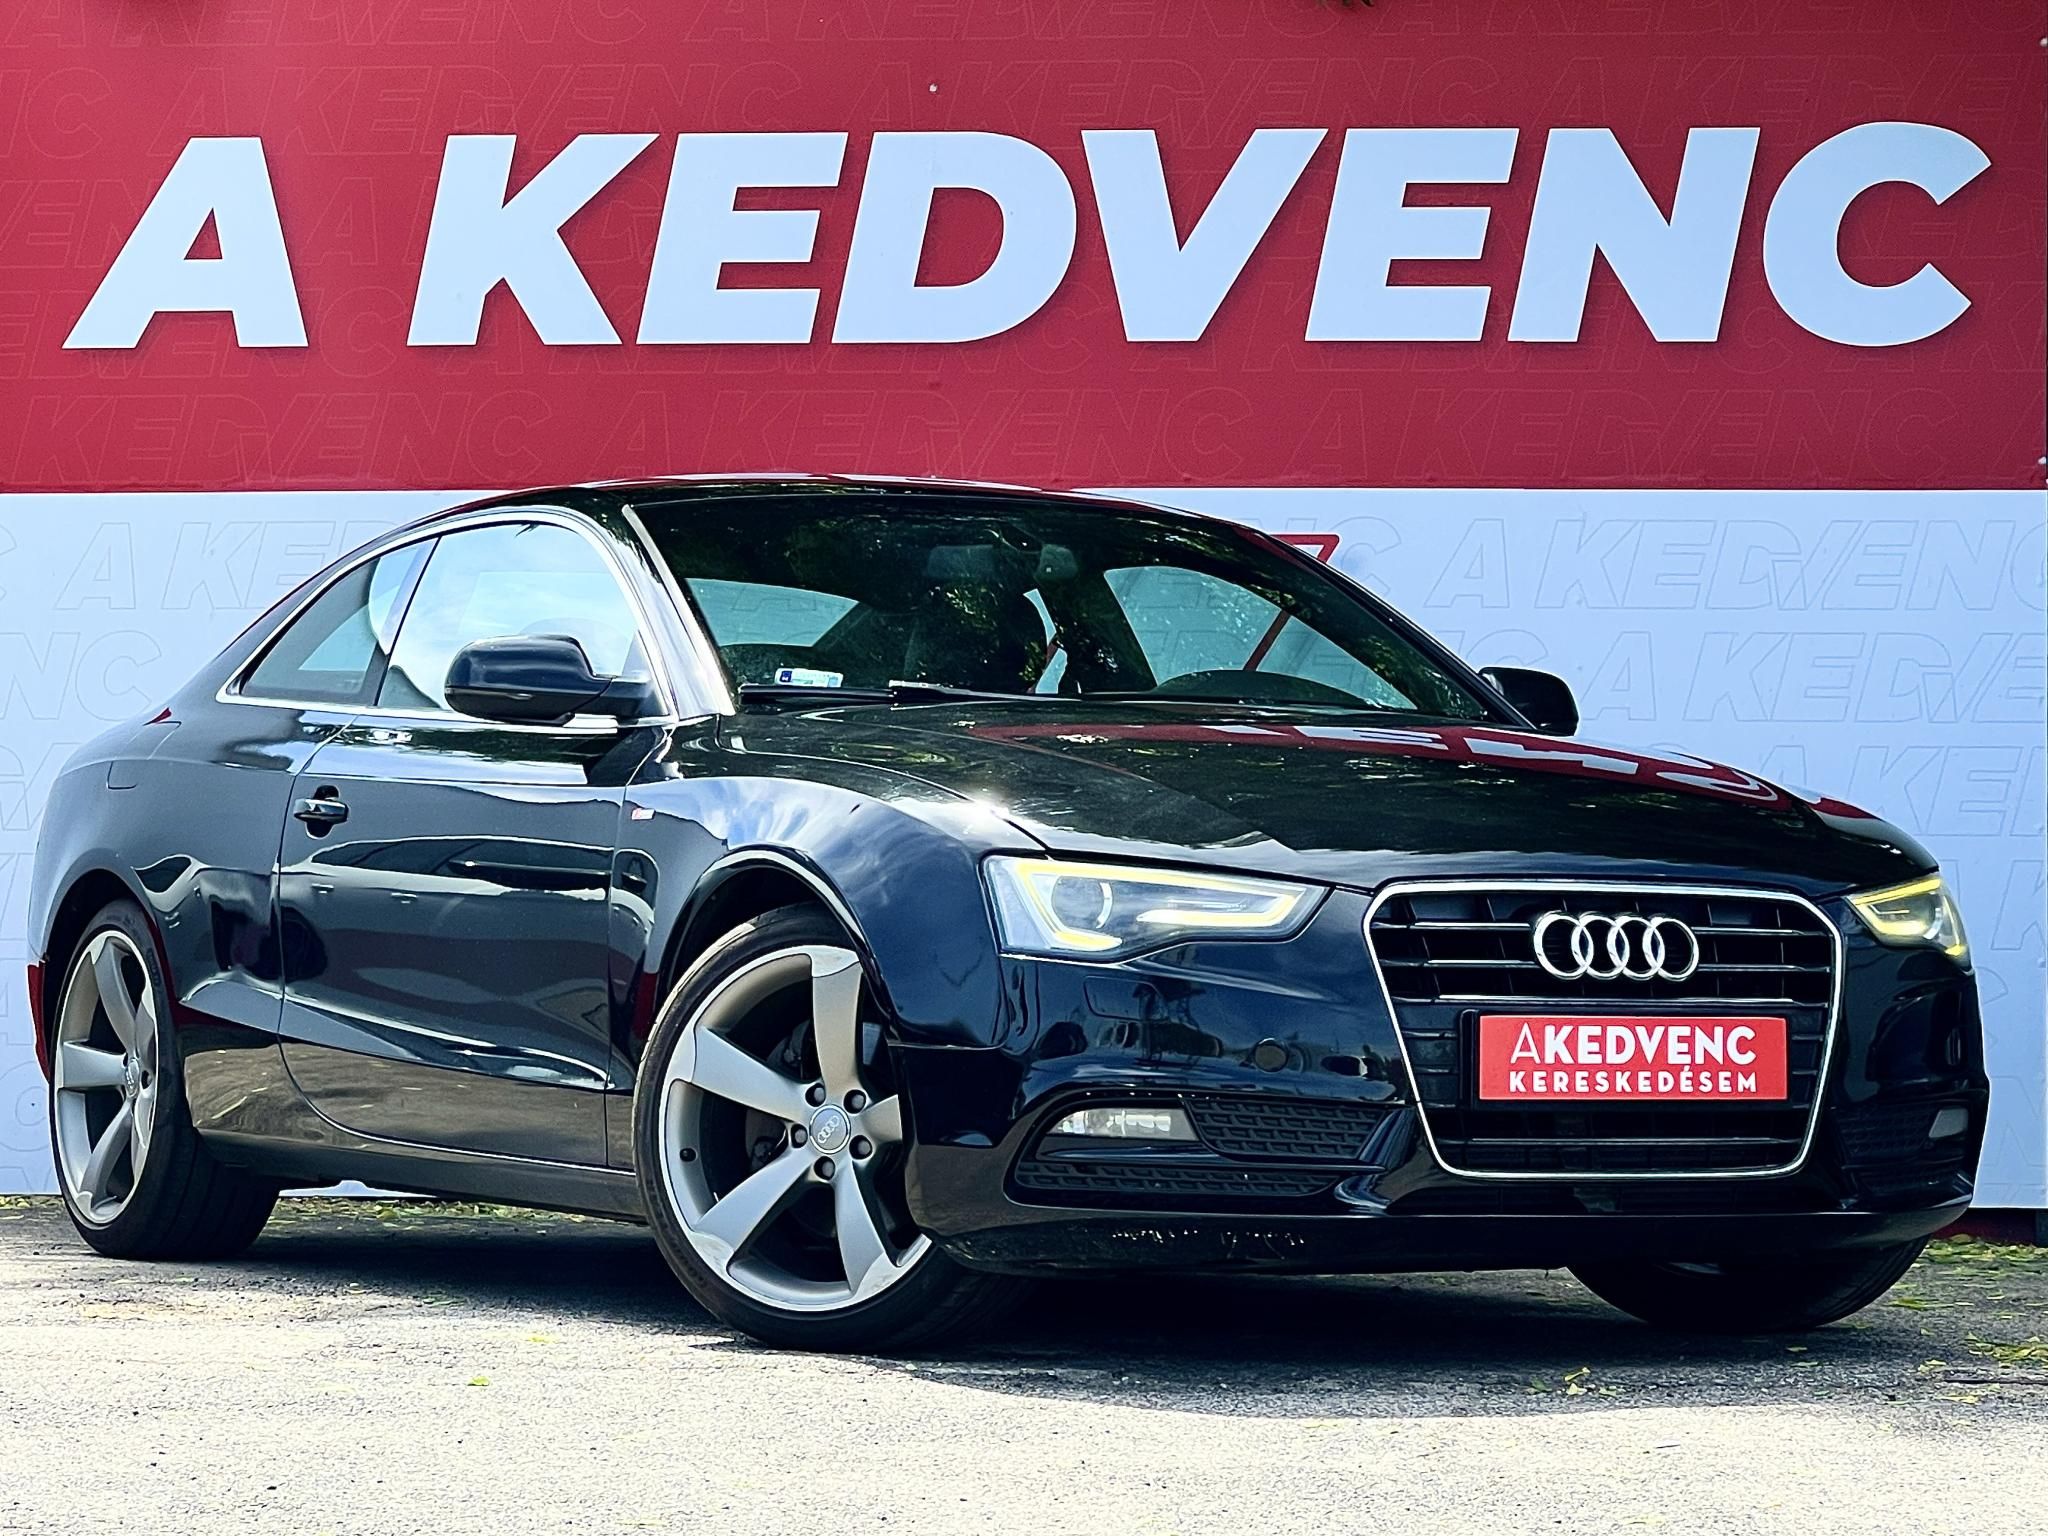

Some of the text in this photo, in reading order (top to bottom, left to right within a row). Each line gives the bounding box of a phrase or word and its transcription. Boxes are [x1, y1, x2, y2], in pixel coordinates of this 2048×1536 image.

[64, 136, 310, 349] A
[407, 121, 1992, 348] KEDVENC
[11, 391, 553, 484] KEDVENC
[698, 386, 1254, 480] KEDVENC
[1394, 387, 1959, 480] KEDVENC
[52, 521, 137, 611] A
[1423, 518, 1511, 609] A
[1509, 1066, 1757, 1093] KERESKEDÉSEM
